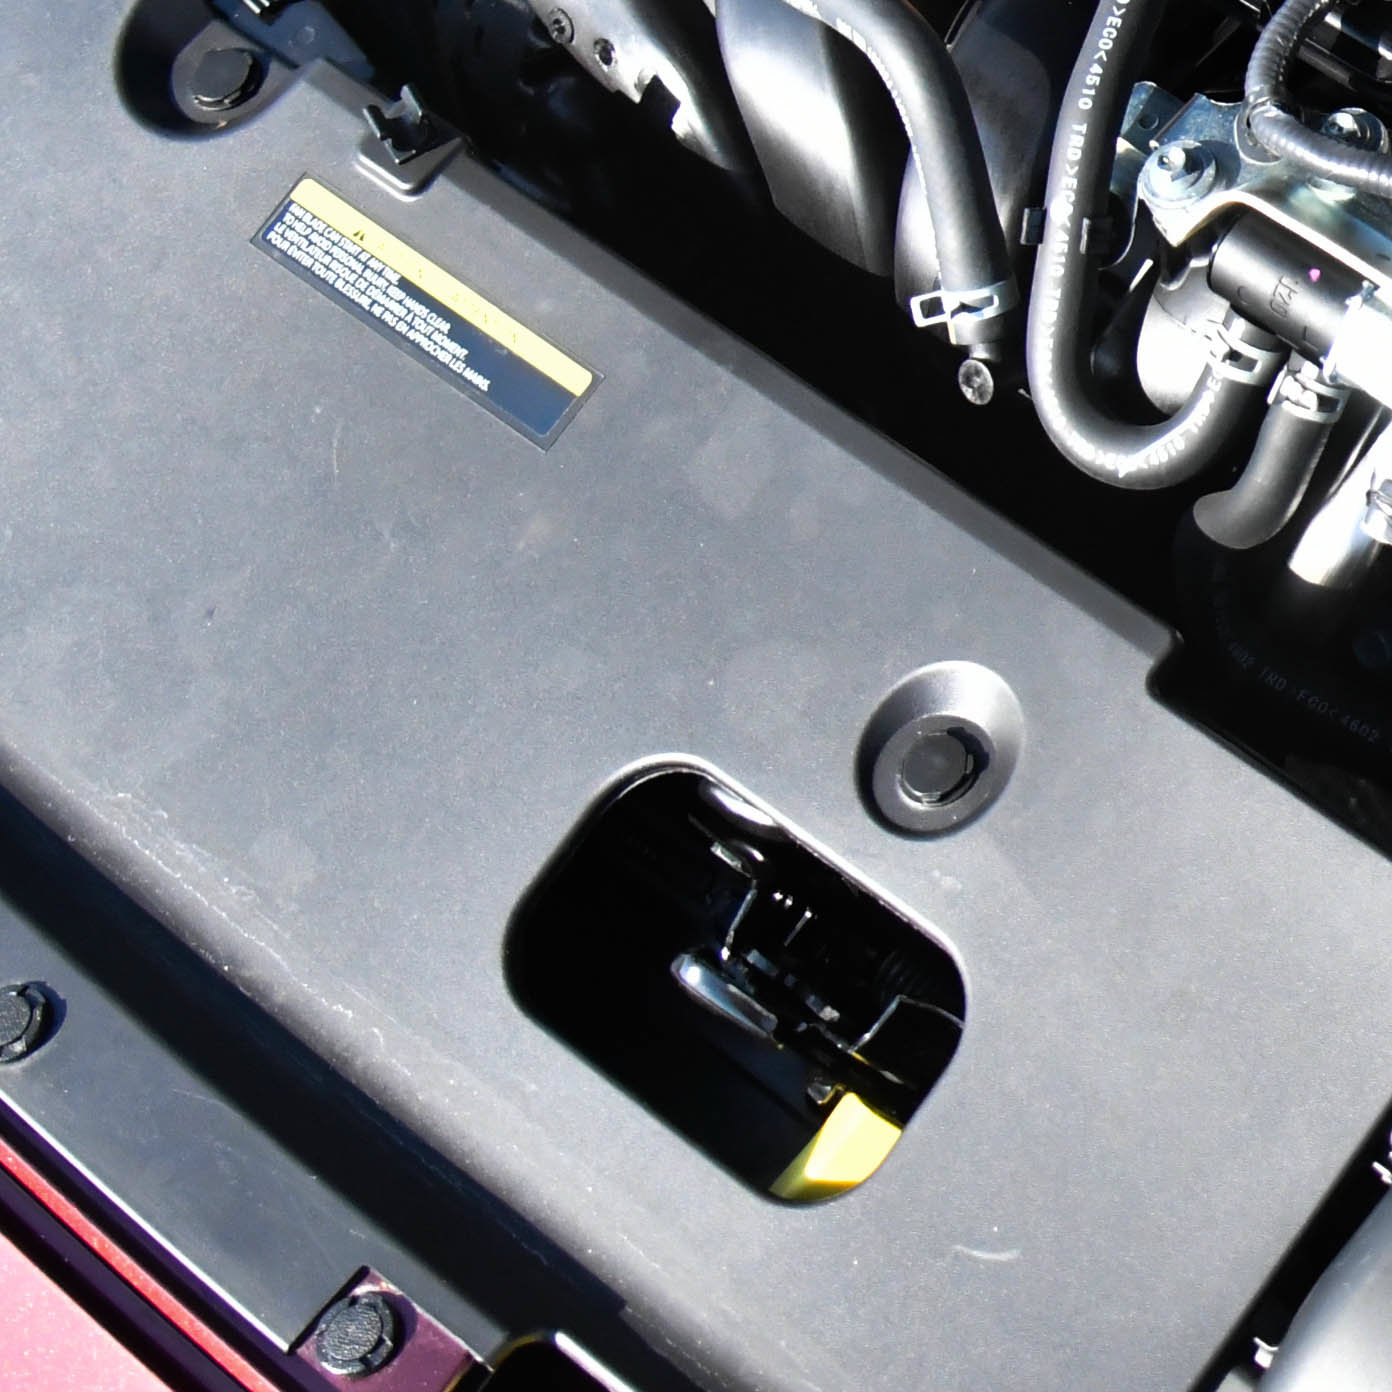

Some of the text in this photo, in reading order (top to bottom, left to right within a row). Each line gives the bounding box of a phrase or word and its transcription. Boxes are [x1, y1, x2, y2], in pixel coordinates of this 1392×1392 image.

[282, 211, 296, 226] TO
[291, 218, 313, 237] HELP
[401, 294, 429, 319] HANDS
[354, 276, 369, 292] DE
[409, 315, 434, 337] TOUT
[380, 309, 399, 328] PAS
[447, 357, 466, 374] LES
